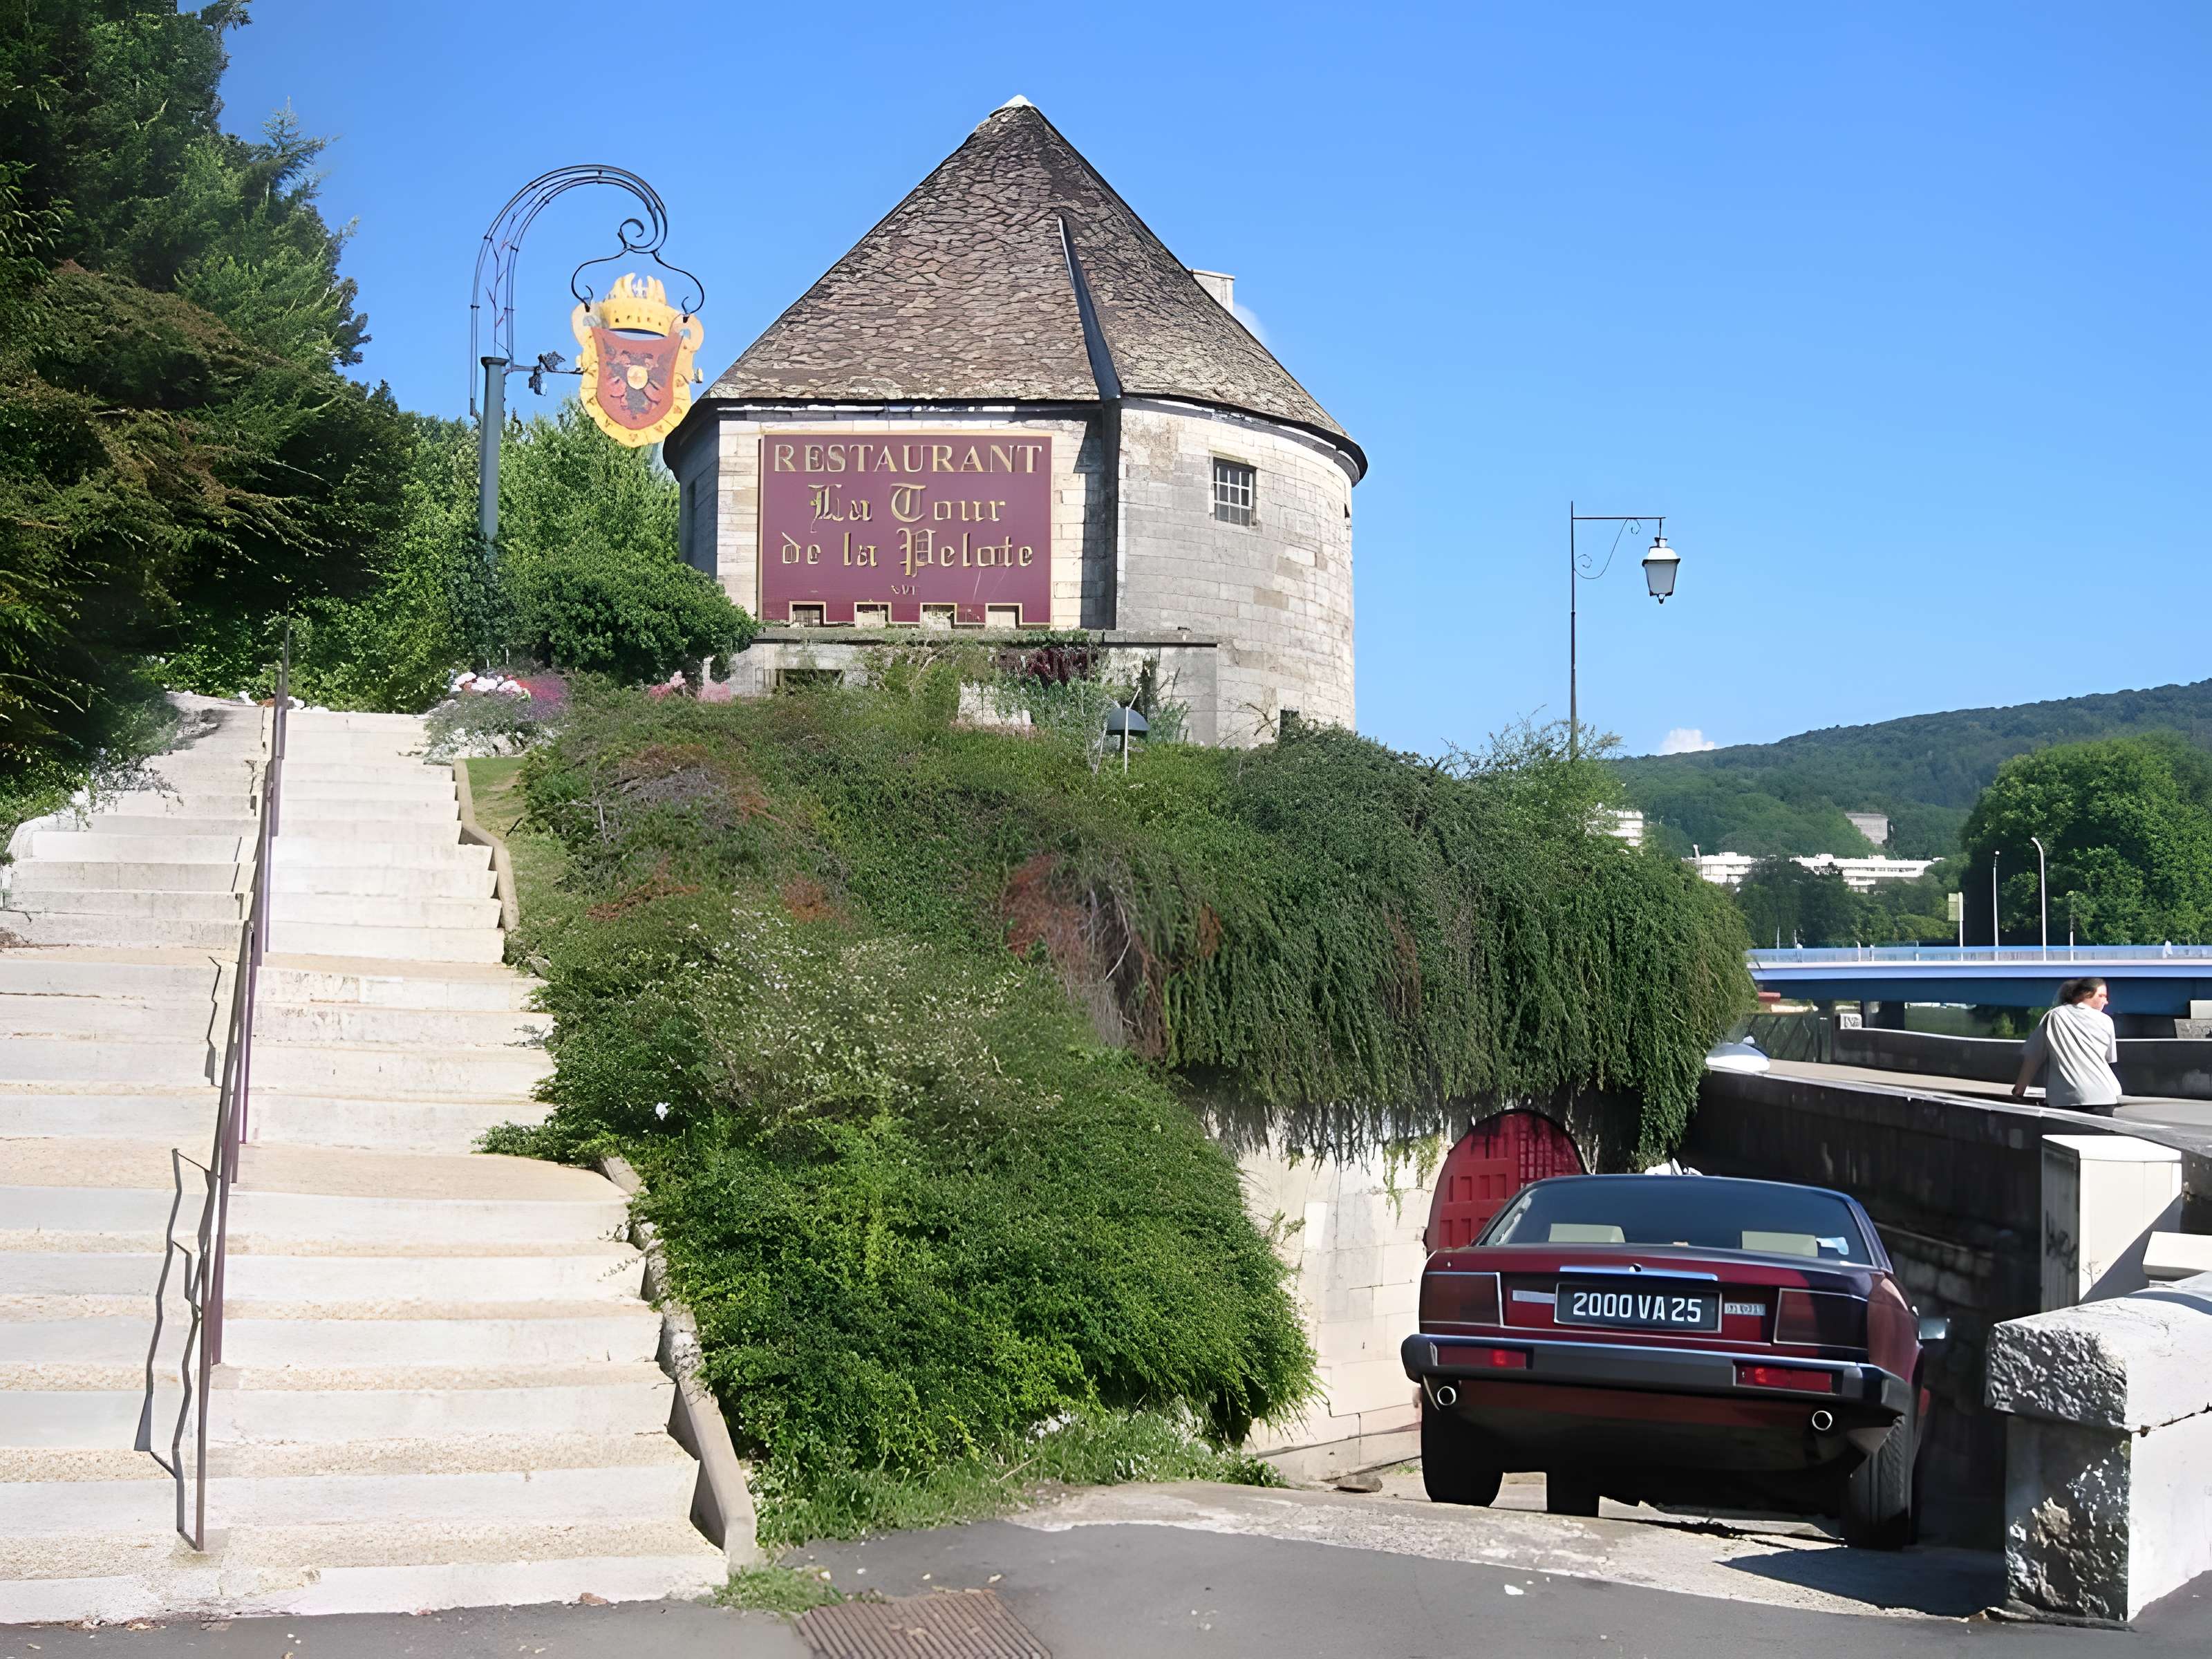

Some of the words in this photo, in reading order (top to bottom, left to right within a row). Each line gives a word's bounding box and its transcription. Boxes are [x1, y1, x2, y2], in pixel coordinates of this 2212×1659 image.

[774, 444, 1042, 473] RESTAURANT
[808, 484, 873, 533] La
[890, 483, 1006, 523] Tour
[781, 532, 821, 565] de
[843, 532, 878, 567] la
[896, 527, 1033, 578] Pelote
[1573, 1292, 1633, 1319] 2000
[1637, 1295, 1666, 1322] VA
[1671, 1297, 1703, 1324] 25
